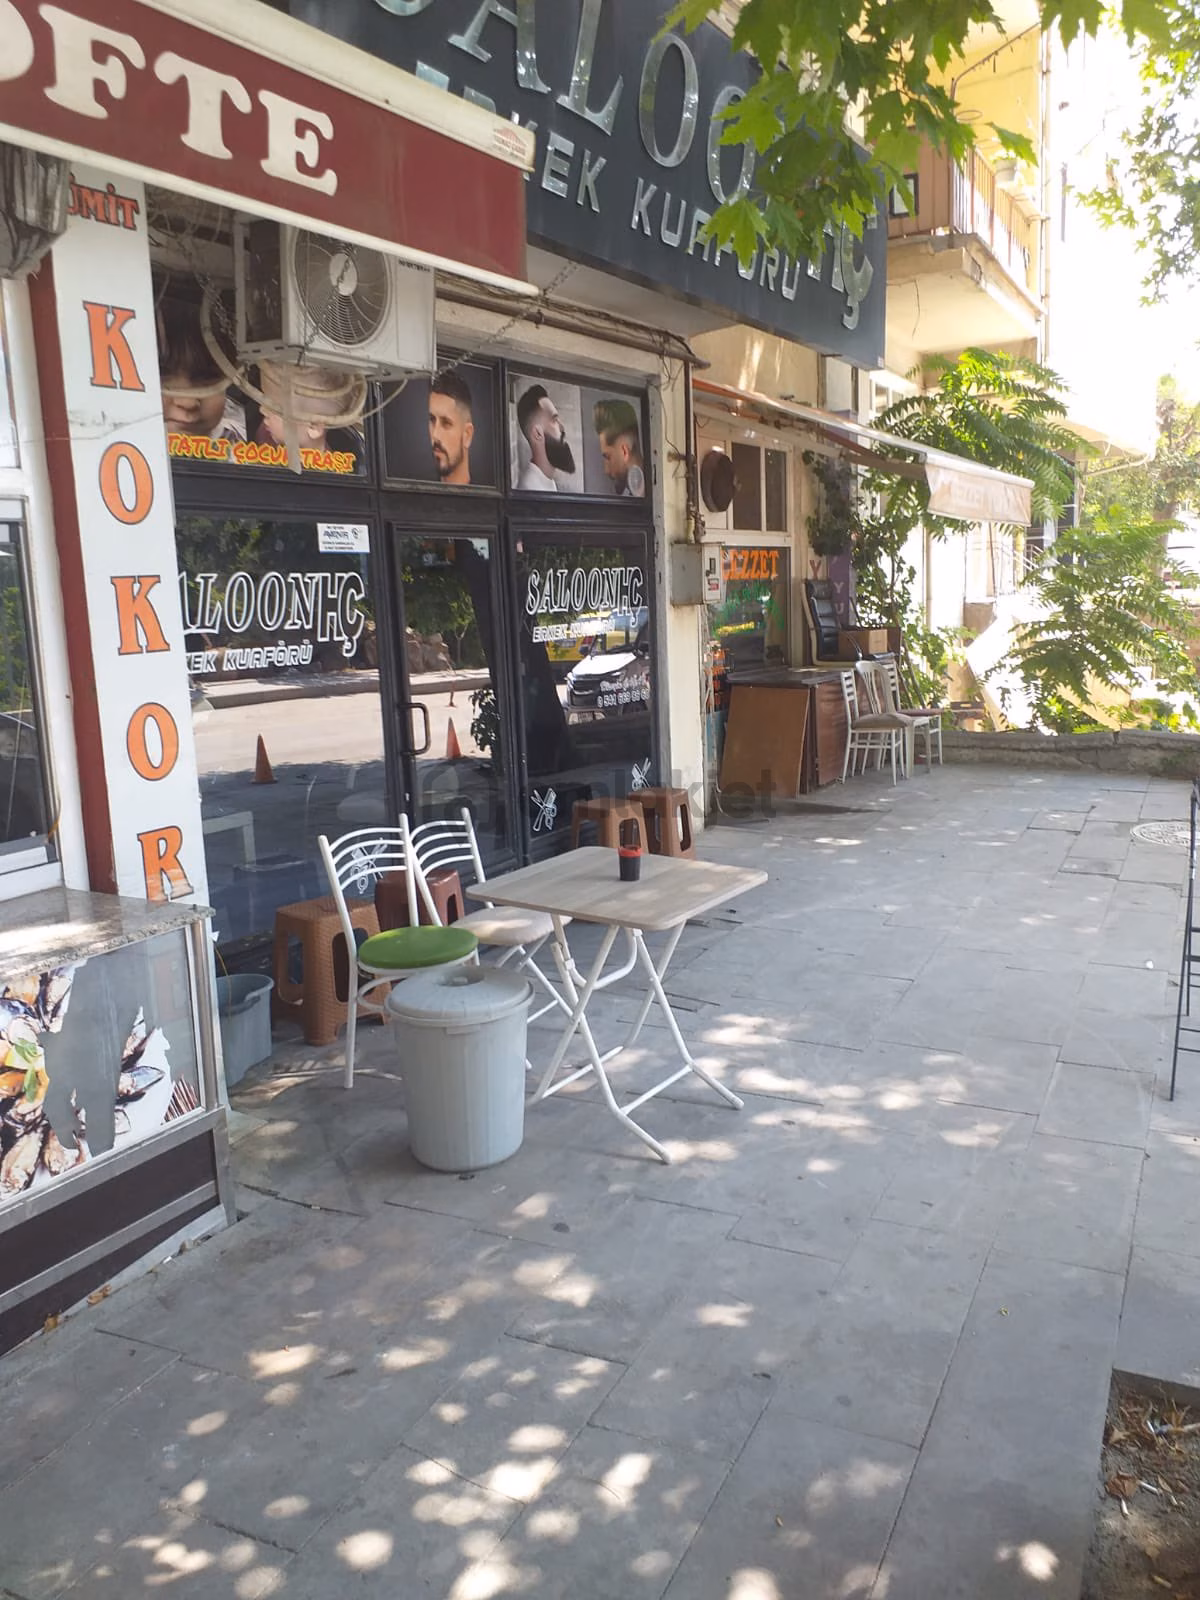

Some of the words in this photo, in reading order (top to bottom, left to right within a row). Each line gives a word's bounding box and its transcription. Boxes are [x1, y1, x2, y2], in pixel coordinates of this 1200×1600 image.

[167, 433, 230, 459] TATLI
[233, 441, 289, 466] ÇOCU
[525, 566, 644, 628] SALOONHÇ
[222, 639, 314, 671] KUAFÖRÜ
